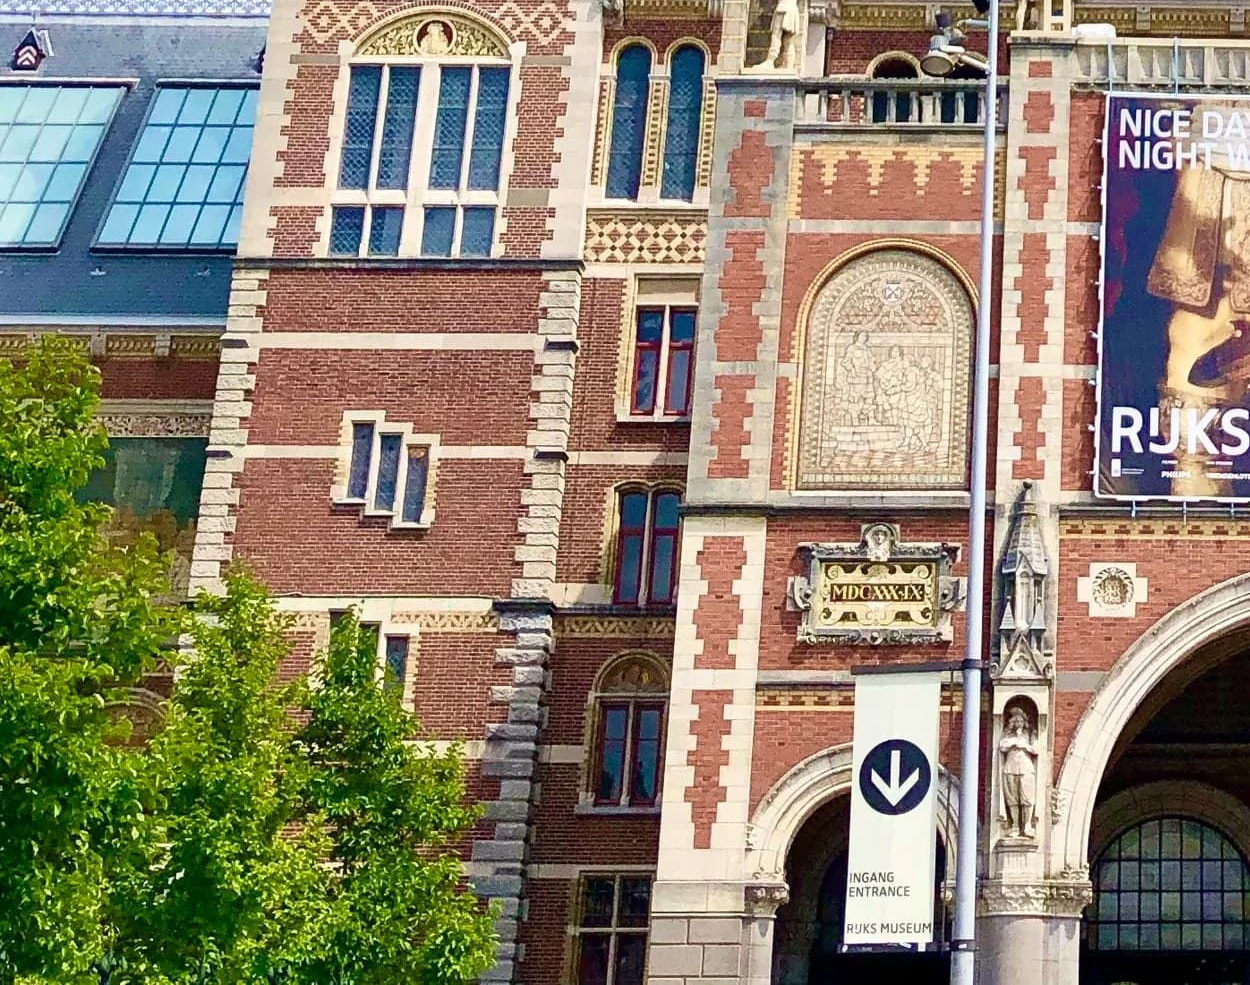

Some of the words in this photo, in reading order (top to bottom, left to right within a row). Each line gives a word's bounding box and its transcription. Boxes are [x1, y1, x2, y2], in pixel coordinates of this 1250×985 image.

[1119, 108, 1191, 138] NICE
[1118, 140, 1217, 170] NIGHT
[849, 871, 895, 884] INGANG
[848, 885, 911, 898] ENTRANCE
[880, 922, 932, 934] MUSEUM
